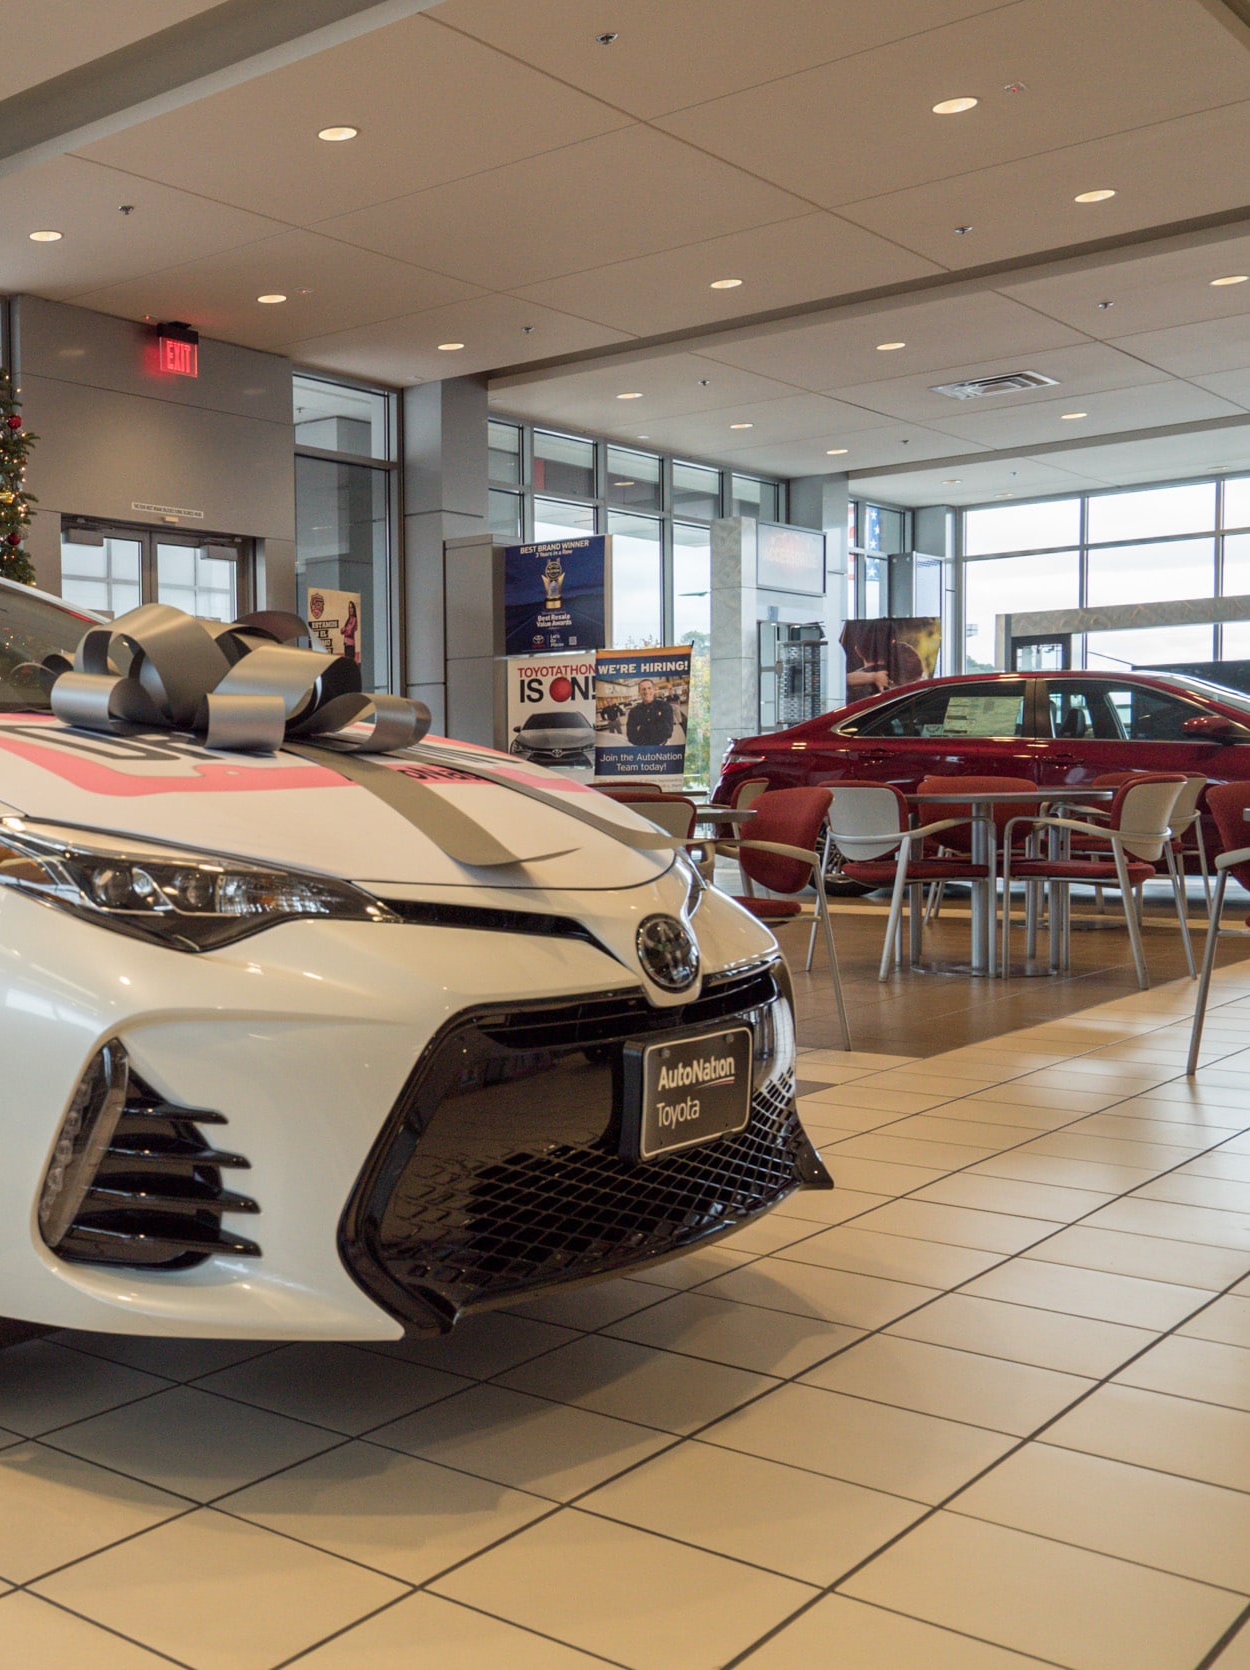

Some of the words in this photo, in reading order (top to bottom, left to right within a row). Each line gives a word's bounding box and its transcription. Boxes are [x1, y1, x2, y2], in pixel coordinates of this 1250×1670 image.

[166, 340, 191, 373] EXIT
[520, 545, 537, 555] BEST
[538, 543, 561, 553] BRAND
[562, 540, 590, 550] WINNER
[518, 664, 596, 678] TOYOTATHON
[598, 664, 637, 675] WE'RE
[640, 660, 688, 673] HIRING!
[520, 679, 544, 703] IS
[600, 753, 618, 762] Join
[620, 753, 634, 761] the
[637, 752, 683, 761] AutoNation
[616, 763, 638, 772] Team
[641, 763, 667, 773] today!
[658, 1056, 735, 1091] AutoNation
[656, 1096, 700, 1129] Toyota
